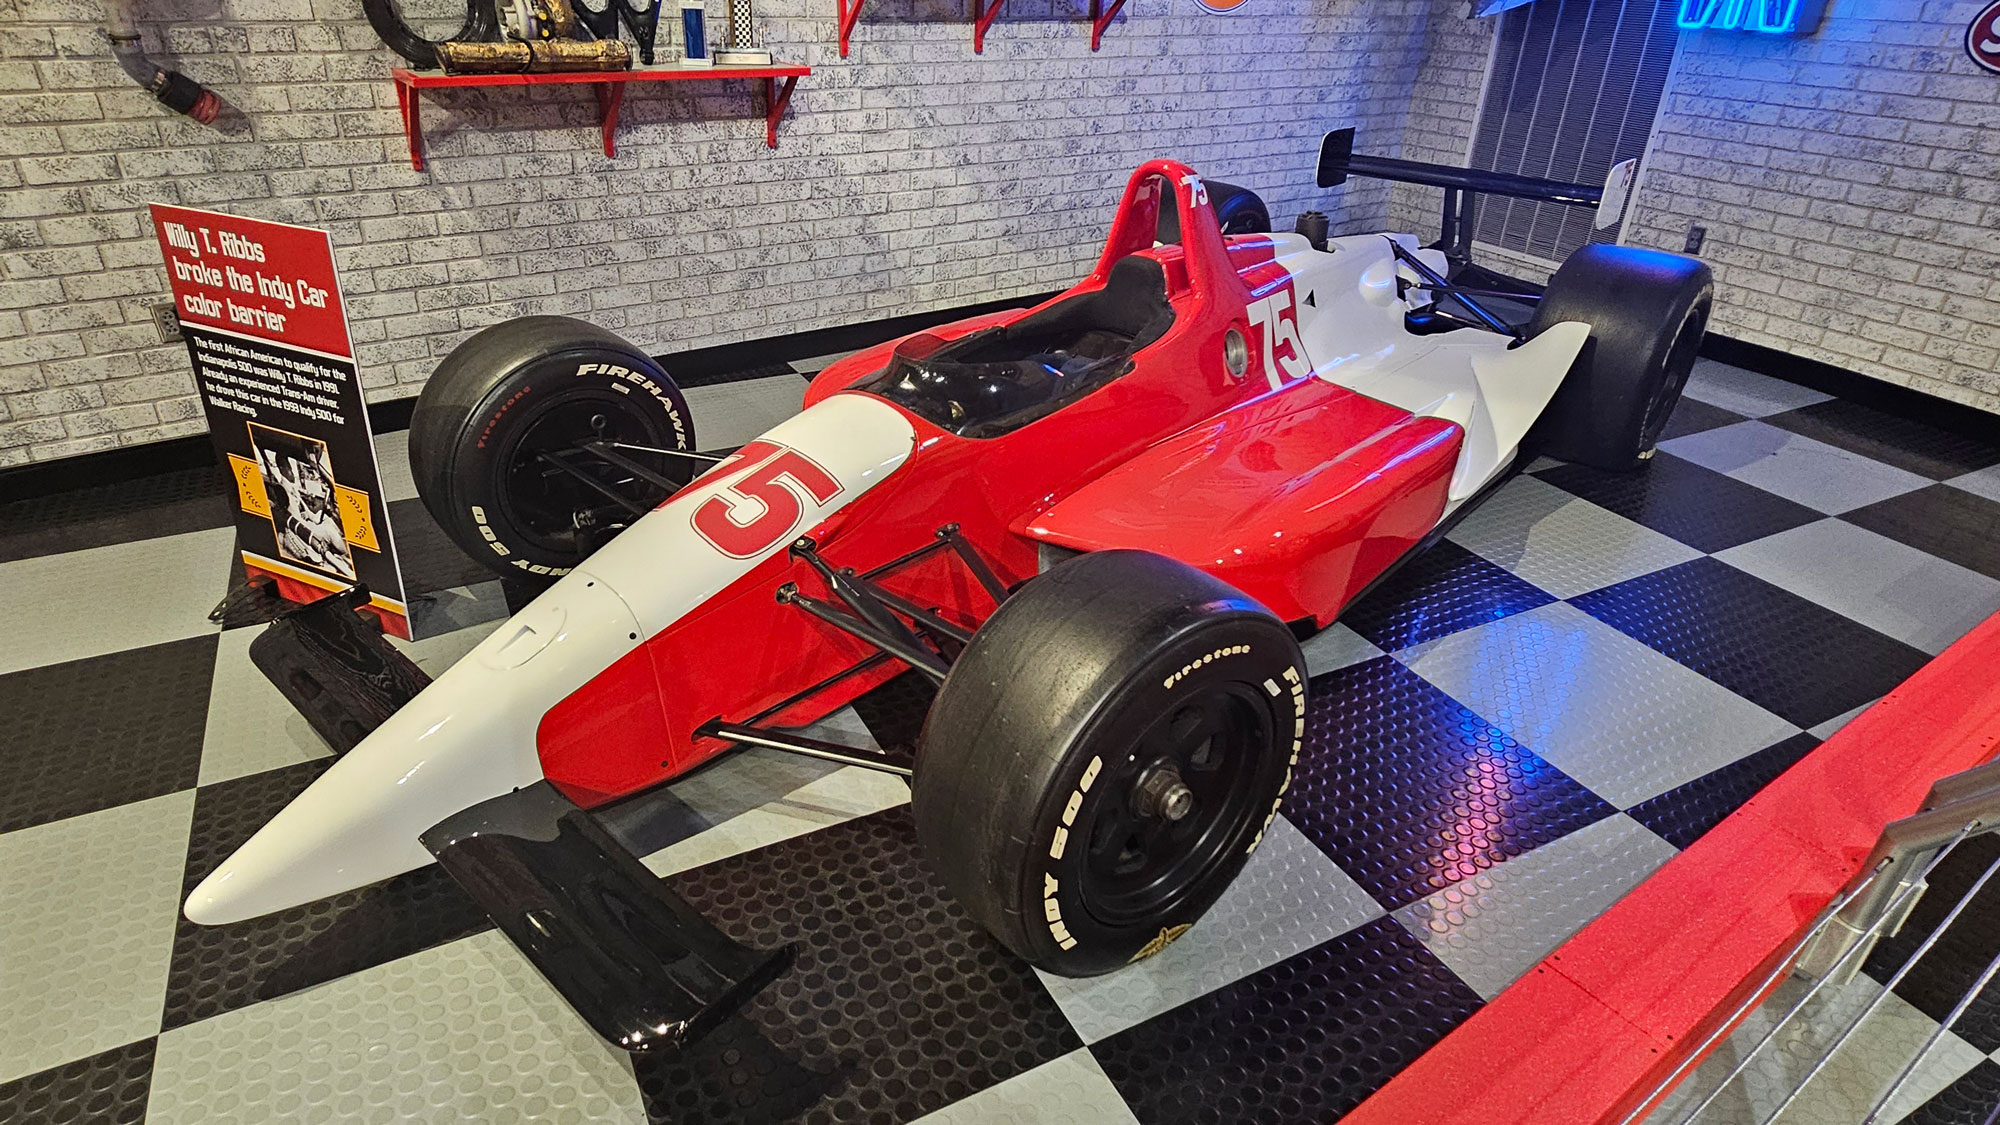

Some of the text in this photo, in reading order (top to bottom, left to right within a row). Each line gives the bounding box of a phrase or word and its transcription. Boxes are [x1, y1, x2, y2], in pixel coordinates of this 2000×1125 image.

[1181, 174, 1208, 208] 75
[163, 222, 265, 263] Willy T. Ribbs
[172, 256, 328, 309] broke the Indy Car
[183, 292, 286, 332] color barrier
[193, 336, 347, 381] The first African American to qualify for the
[1246, 289, 1312, 390] 75
[197, 351, 238, 369] Indianapolis
[237, 360, 253, 373] 500
[253, 366, 269, 377] was
[267, 368, 286, 383] Willy
[285, 372, 293, 383] T.
[293, 374, 314, 388] Ribbs
[314, 378, 322, 390] in
[202, 366, 229, 384] Already
[229, 374, 238, 384] an
[238, 377, 281, 395] experienced
[280, 385, 316, 403] Trans-Am
[205, 380, 345, 425] he drove this car in the 1993 Indy 500 for
[576, 363, 686, 451] FIREHAWK
[471, 505, 572, 576] NDY 500
[1044, 755, 1103, 950] INDY 500
